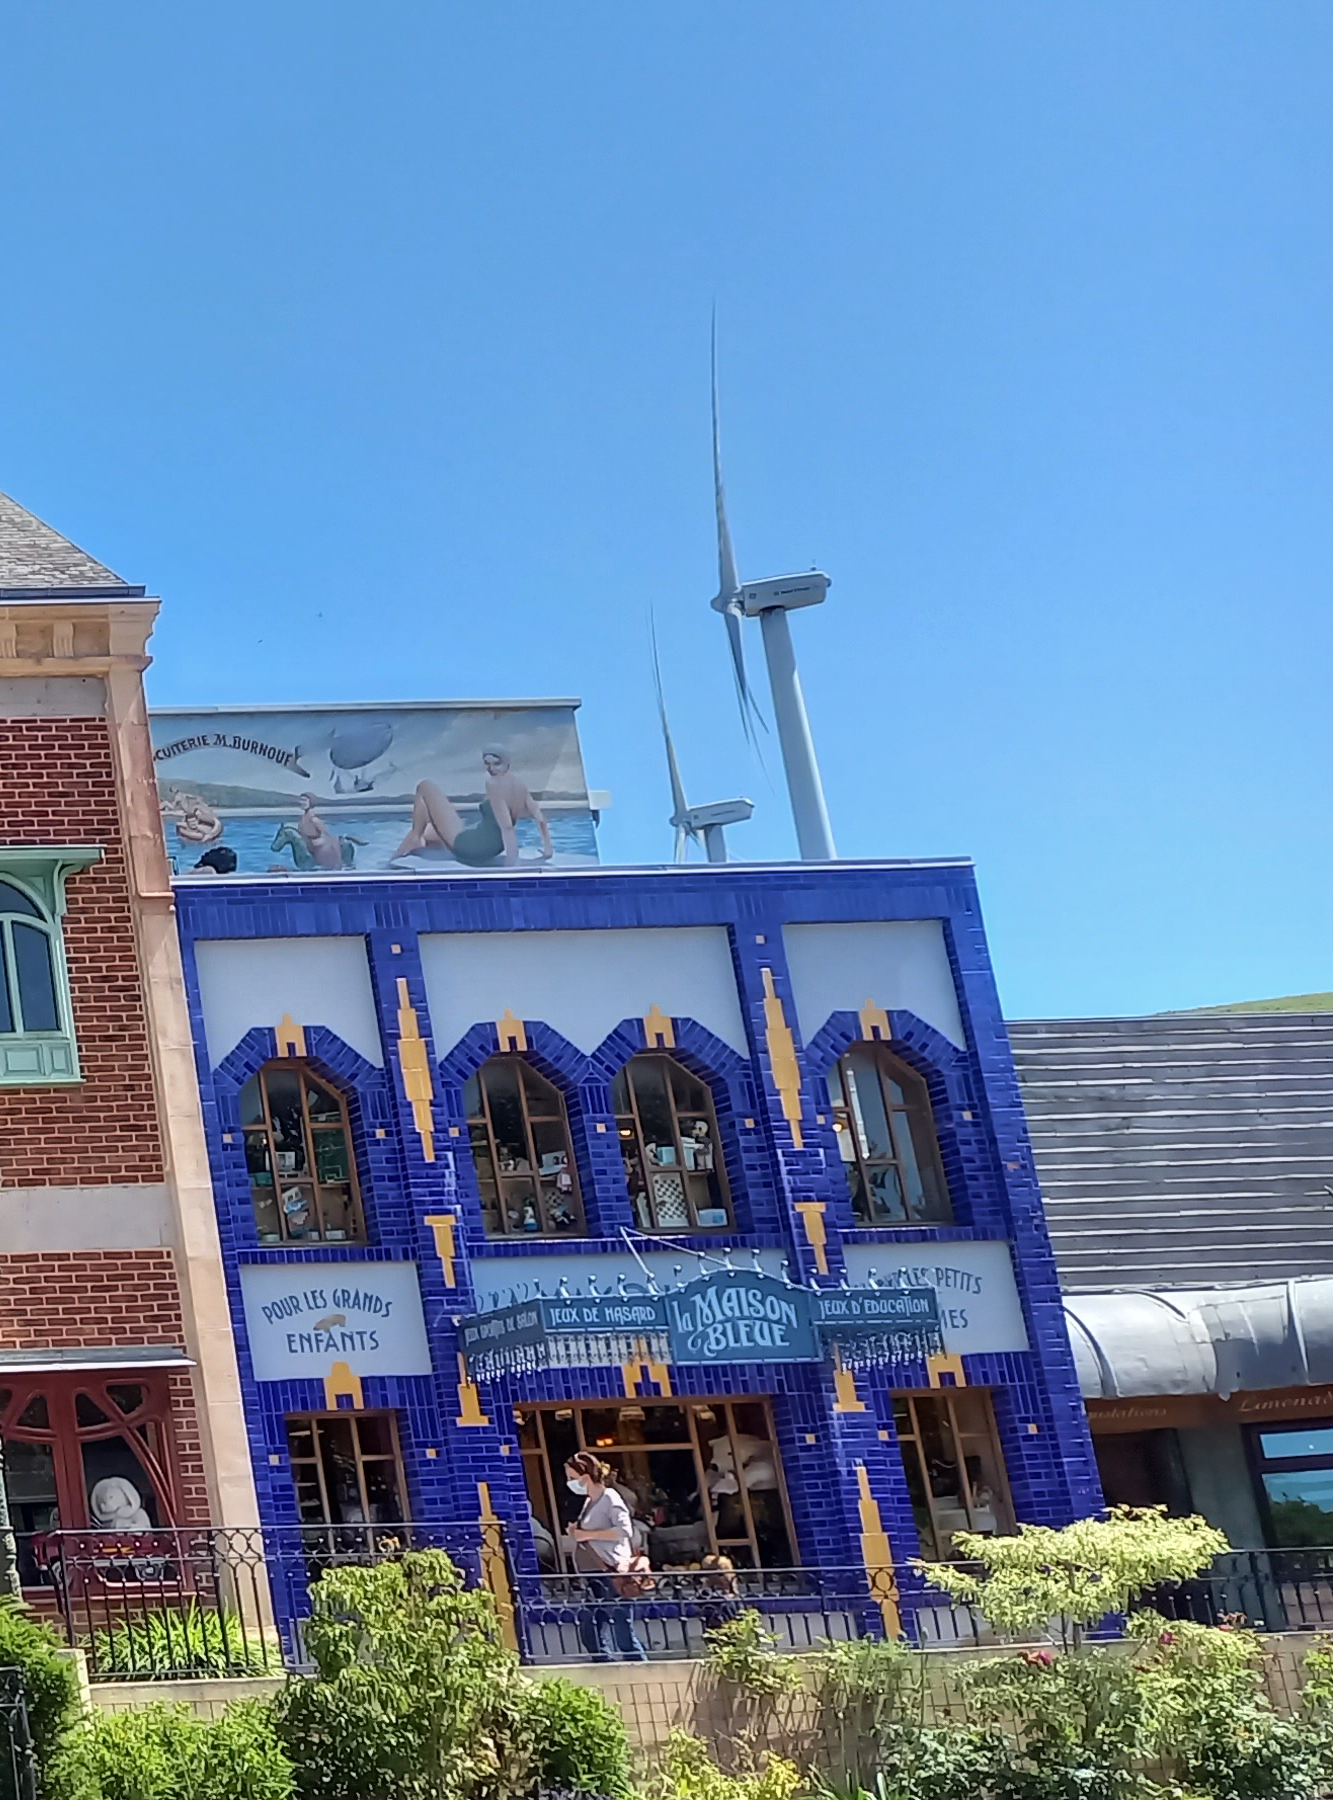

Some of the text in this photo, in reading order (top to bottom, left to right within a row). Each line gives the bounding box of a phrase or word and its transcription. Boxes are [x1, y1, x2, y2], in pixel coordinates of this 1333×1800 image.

[934, 1266, 984, 1295] PETITS
[261, 1287, 393, 1325] POUR LES GRANDS
[549, 1305, 656, 1326] JEUX DE HASARD
[671, 1300, 694, 1333] la
[688, 1285, 798, 1351] MAISON
[817, 1299, 850, 1320] JEUX
[285, 1329, 380, 1354] ENFANTS
[703, 1319, 790, 1357] BLEUE
